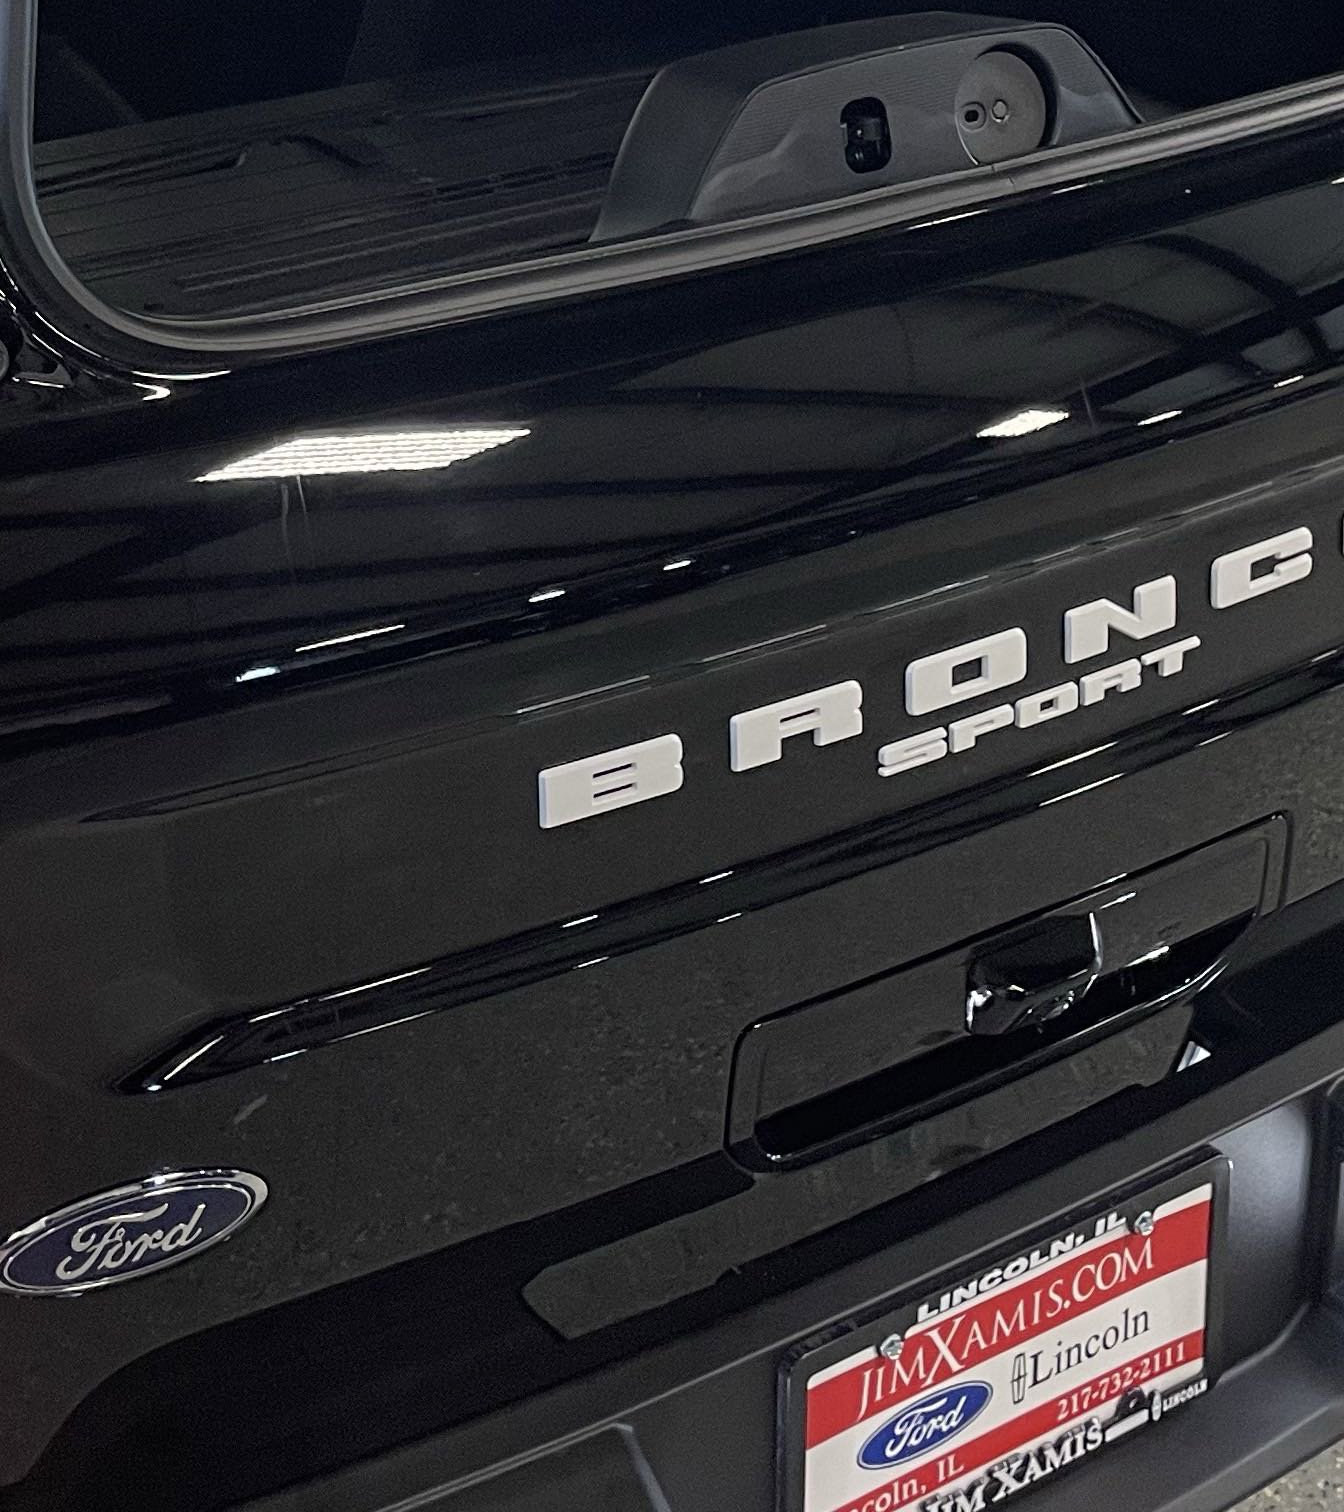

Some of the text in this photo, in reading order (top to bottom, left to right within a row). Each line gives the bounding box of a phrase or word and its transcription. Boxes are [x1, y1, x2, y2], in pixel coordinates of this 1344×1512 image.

[876, 635, 1202, 777] SPORT
[56, 1203, 207, 1281] Ford
[916, 1211, 1128, 1322] LINCOLN, IL
[856, 1238, 1156, 1422] JIMXAMIS.COM
[1028, 1307, 1150, 1388] Lincoln
[1056, 1341, 1186, 1420] 217-732-2111
[884, 1395, 966, 1458] Ford
[992, 1417, 1102, 1503] XAMIS
[937, 1453, 965, 1483] IL
